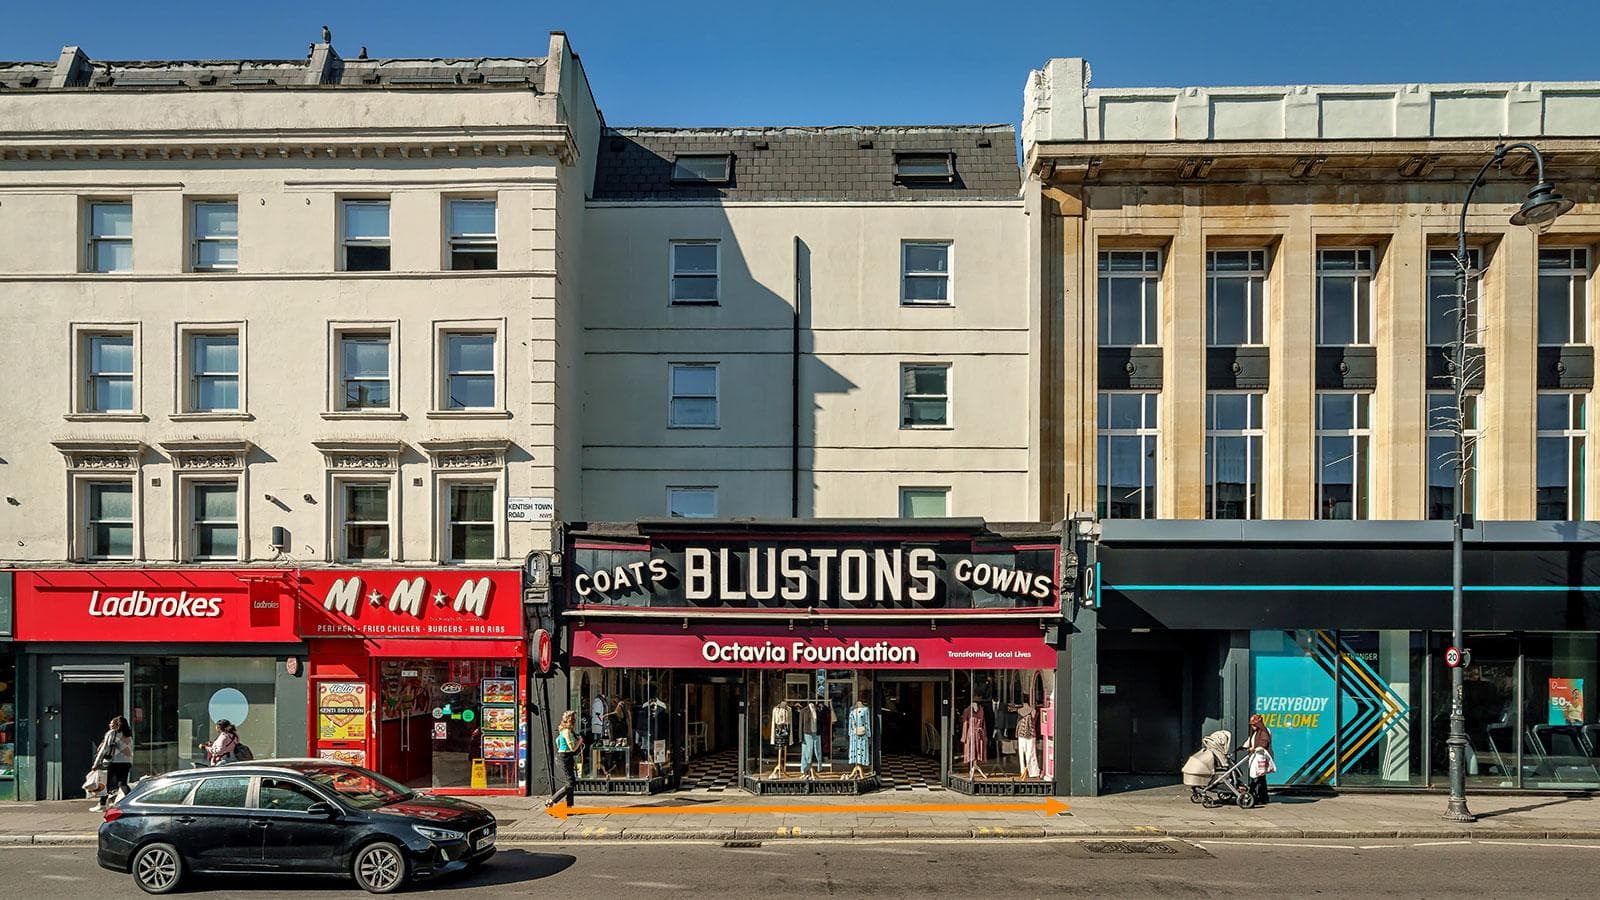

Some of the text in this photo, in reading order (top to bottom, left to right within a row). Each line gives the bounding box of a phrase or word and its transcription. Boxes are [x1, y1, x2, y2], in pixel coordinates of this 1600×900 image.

[575, 558, 668, 596] COATS
[685, 547, 936, 600] BLUSTONS
[954, 559, 1052, 598] GOWNS
[88, 591, 222, 617] Ladbrokes
[253, 600, 279, 609] Ladbrokes
[323, 576, 492, 617] M M M
[363, 625, 385, 633] FRIED
[387, 625, 420, 633] CHICKEN
[428, 625, 462, 633] BURGERS
[470, 625, 485, 633] BBQ
[487, 625, 505, 633] RIBS
[702, 641, 916, 662] Octavia Foundation
[948, 651, 992, 659] Transforming
[1448, 653, 1457, 662] 20
[1256, 696, 1328, 711] EVERYBODY
